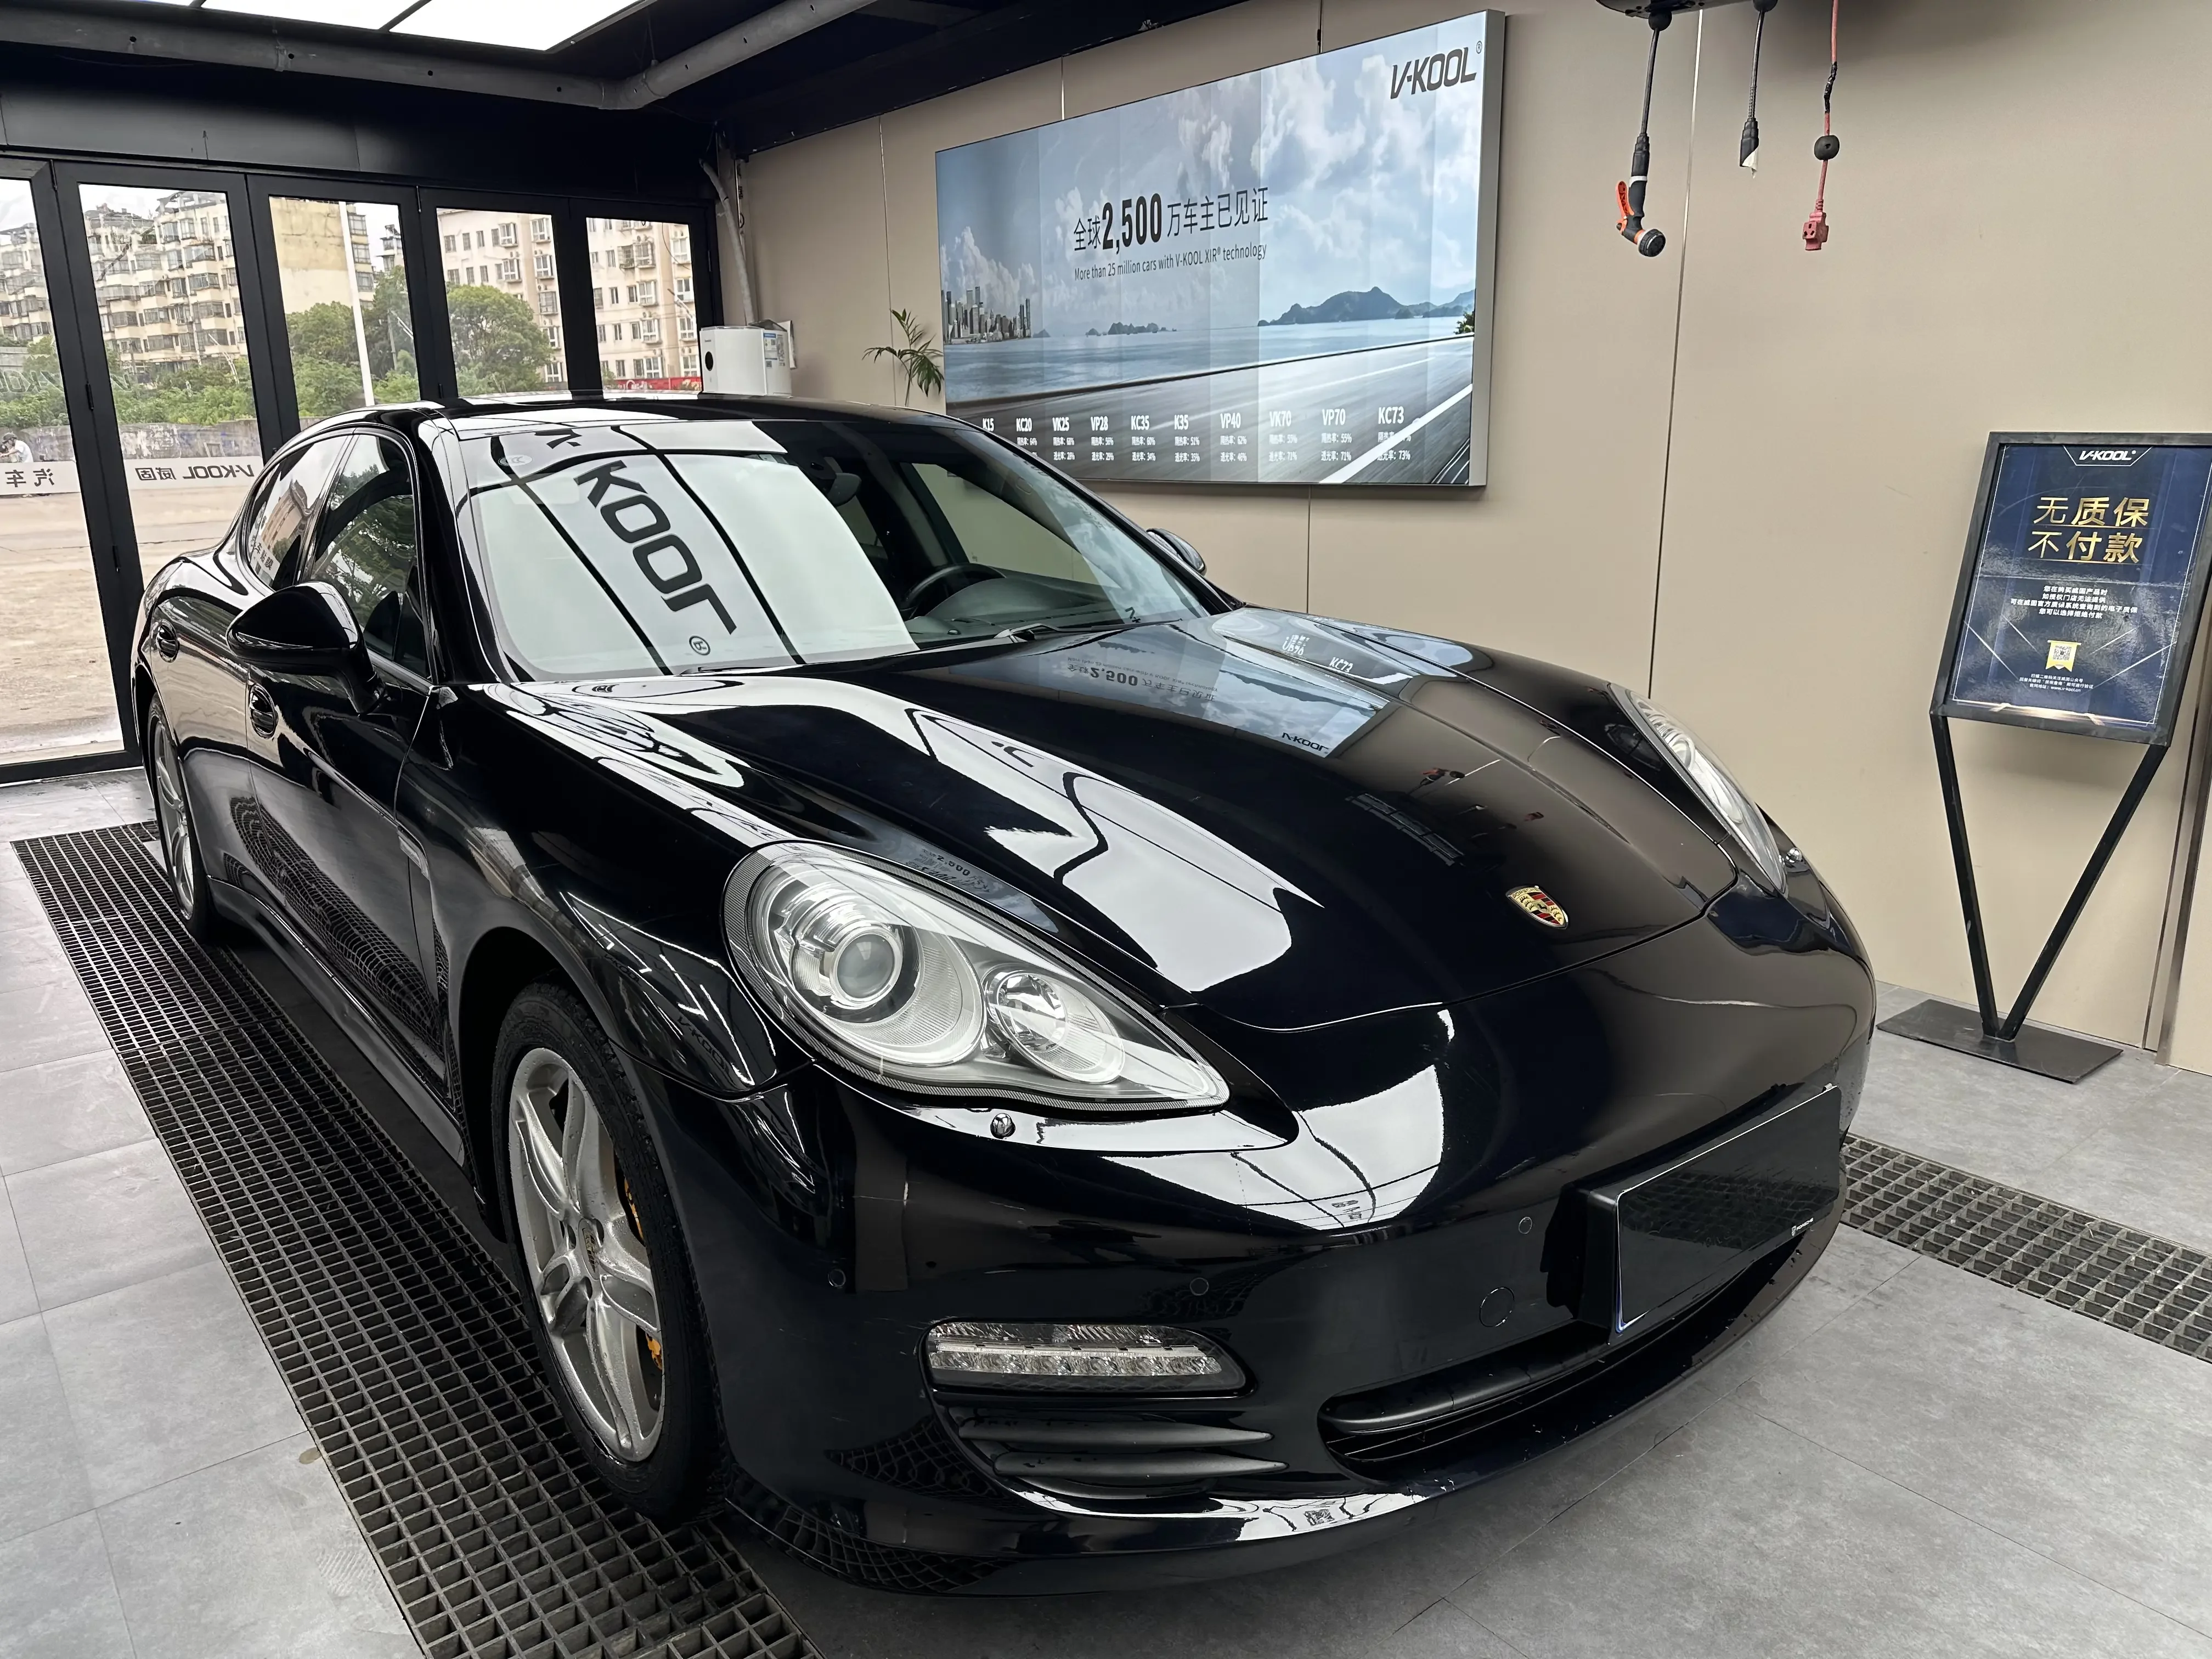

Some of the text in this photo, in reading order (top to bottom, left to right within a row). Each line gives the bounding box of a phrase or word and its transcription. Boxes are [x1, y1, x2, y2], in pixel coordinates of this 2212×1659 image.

[1075, 268, 1090, 280] More
[1092, 264, 1106, 279] than
[1108, 263, 1115, 276] 25
[1118, 260, 1141, 275] million
[1142, 259, 1156, 272] cars
[1158, 253, 1173, 269] with
[1175, 251, 1203, 267] V-KOOL
[1223, 241, 1267, 261] technology
[983, 406, 1404, 432] K15 KC20 VK25 VP28 KC35 K35 VP40 VK70 VP70 KC73
[2033, 496, 2149, 528] 无质保
[2028, 531, 2143, 563] 不付款
